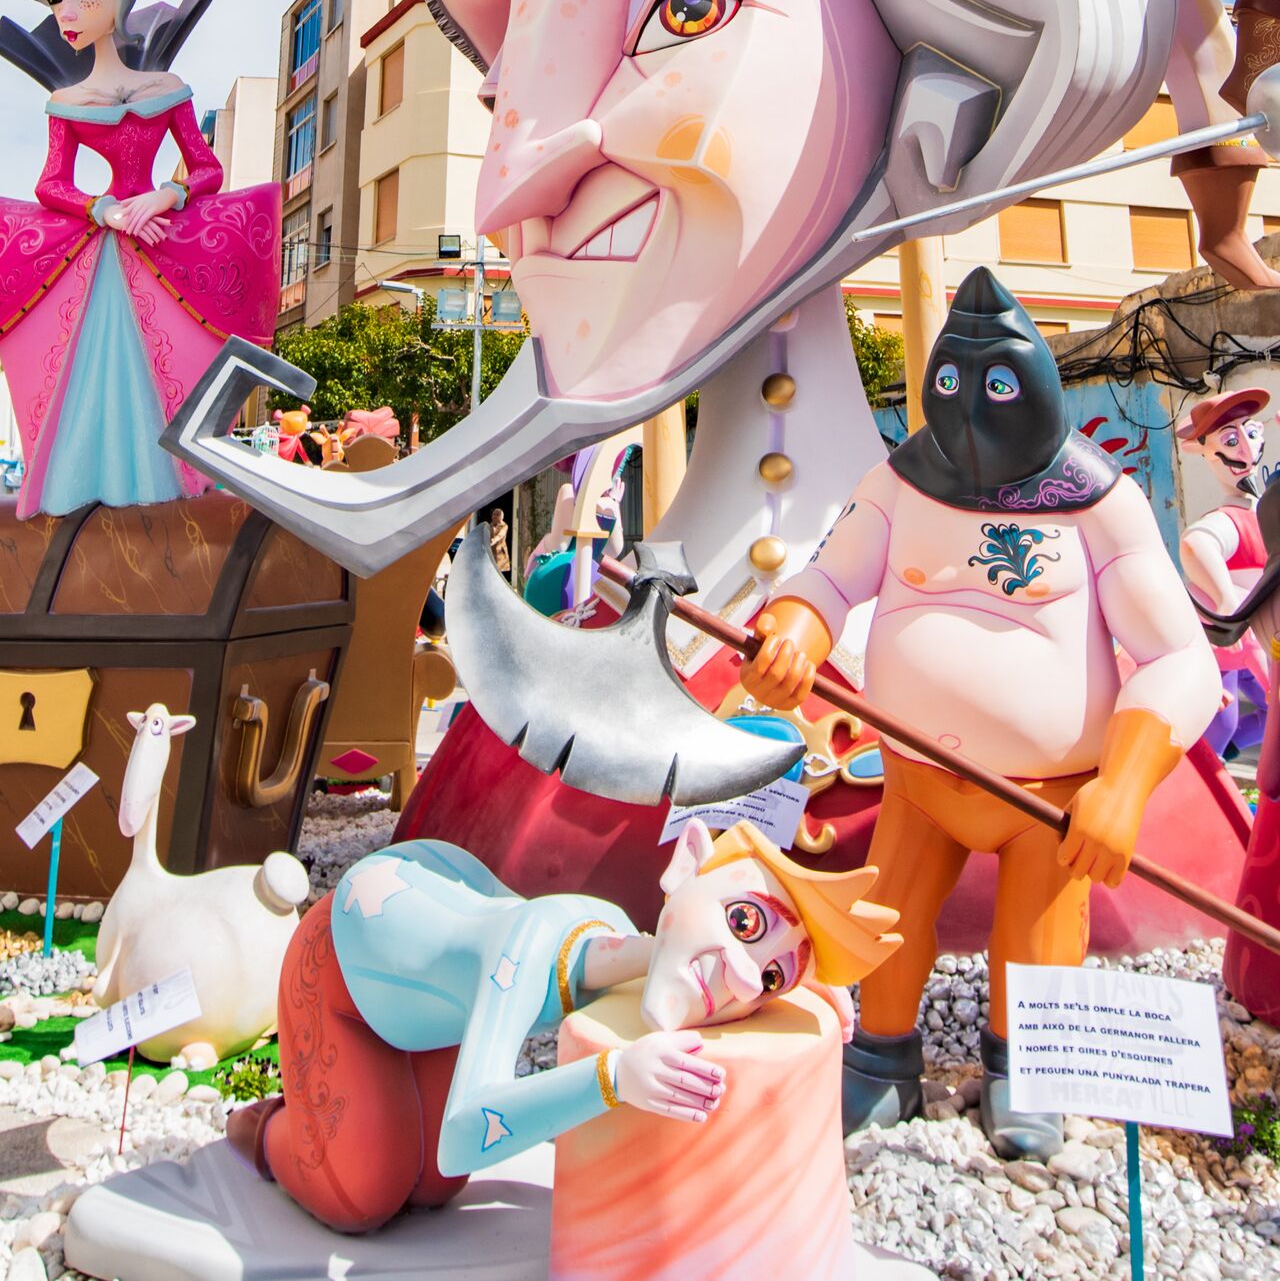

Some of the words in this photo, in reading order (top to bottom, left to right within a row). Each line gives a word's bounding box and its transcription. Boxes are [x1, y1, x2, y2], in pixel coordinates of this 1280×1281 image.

[1018, 1001, 1026, 1010] A
[1029, 1002, 1060, 1010] MOLTS
[1064, 1002, 1090, 1012] SE'LS
[1094, 1006, 1126, 1016] OMPLE
[1129, 1010, 1141, 1018] LA
[1145, 1012, 1172, 1022] BOCA
[1018, 1023, 1039, 1031] AMB
[1068, 1024, 1081, 1032] DE
[1084, 1026, 1097, 1034] LA
[1100, 1027, 1155, 1042] GERMANOR
[1159, 1036, 1201, 1048] FALLERA
[1026, 1045, 1060, 1053] NOMÉS
[1079, 1047, 1108, 1057] GIRES
[1111, 1050, 1174, 1066] D'ESQUENES
[1035, 1067, 1075, 1076] PEGUEN
[1078, 1069, 1099, 1078] UNA
[1102, 1072, 1161, 1086] PUNYALADA
[1165, 1080, 1211, 1094] TRAPERA
